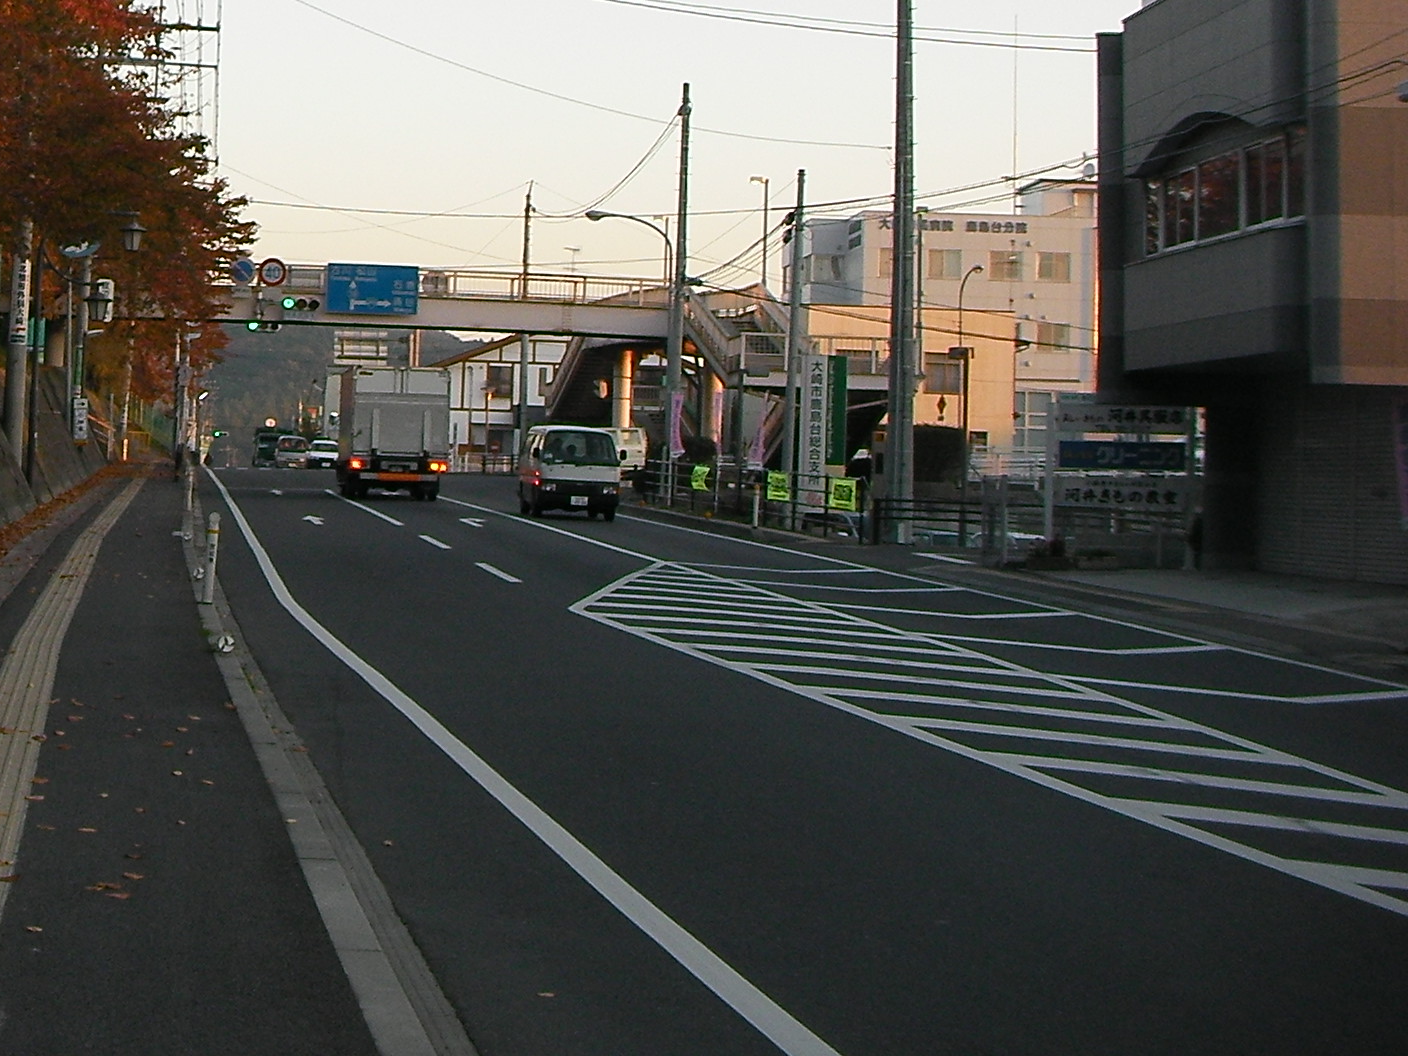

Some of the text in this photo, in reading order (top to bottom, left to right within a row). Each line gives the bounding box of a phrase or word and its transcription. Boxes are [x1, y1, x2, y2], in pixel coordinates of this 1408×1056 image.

[265, 266, 280, 279] 40
[1096, 446, 1180, 465] クリーニング
